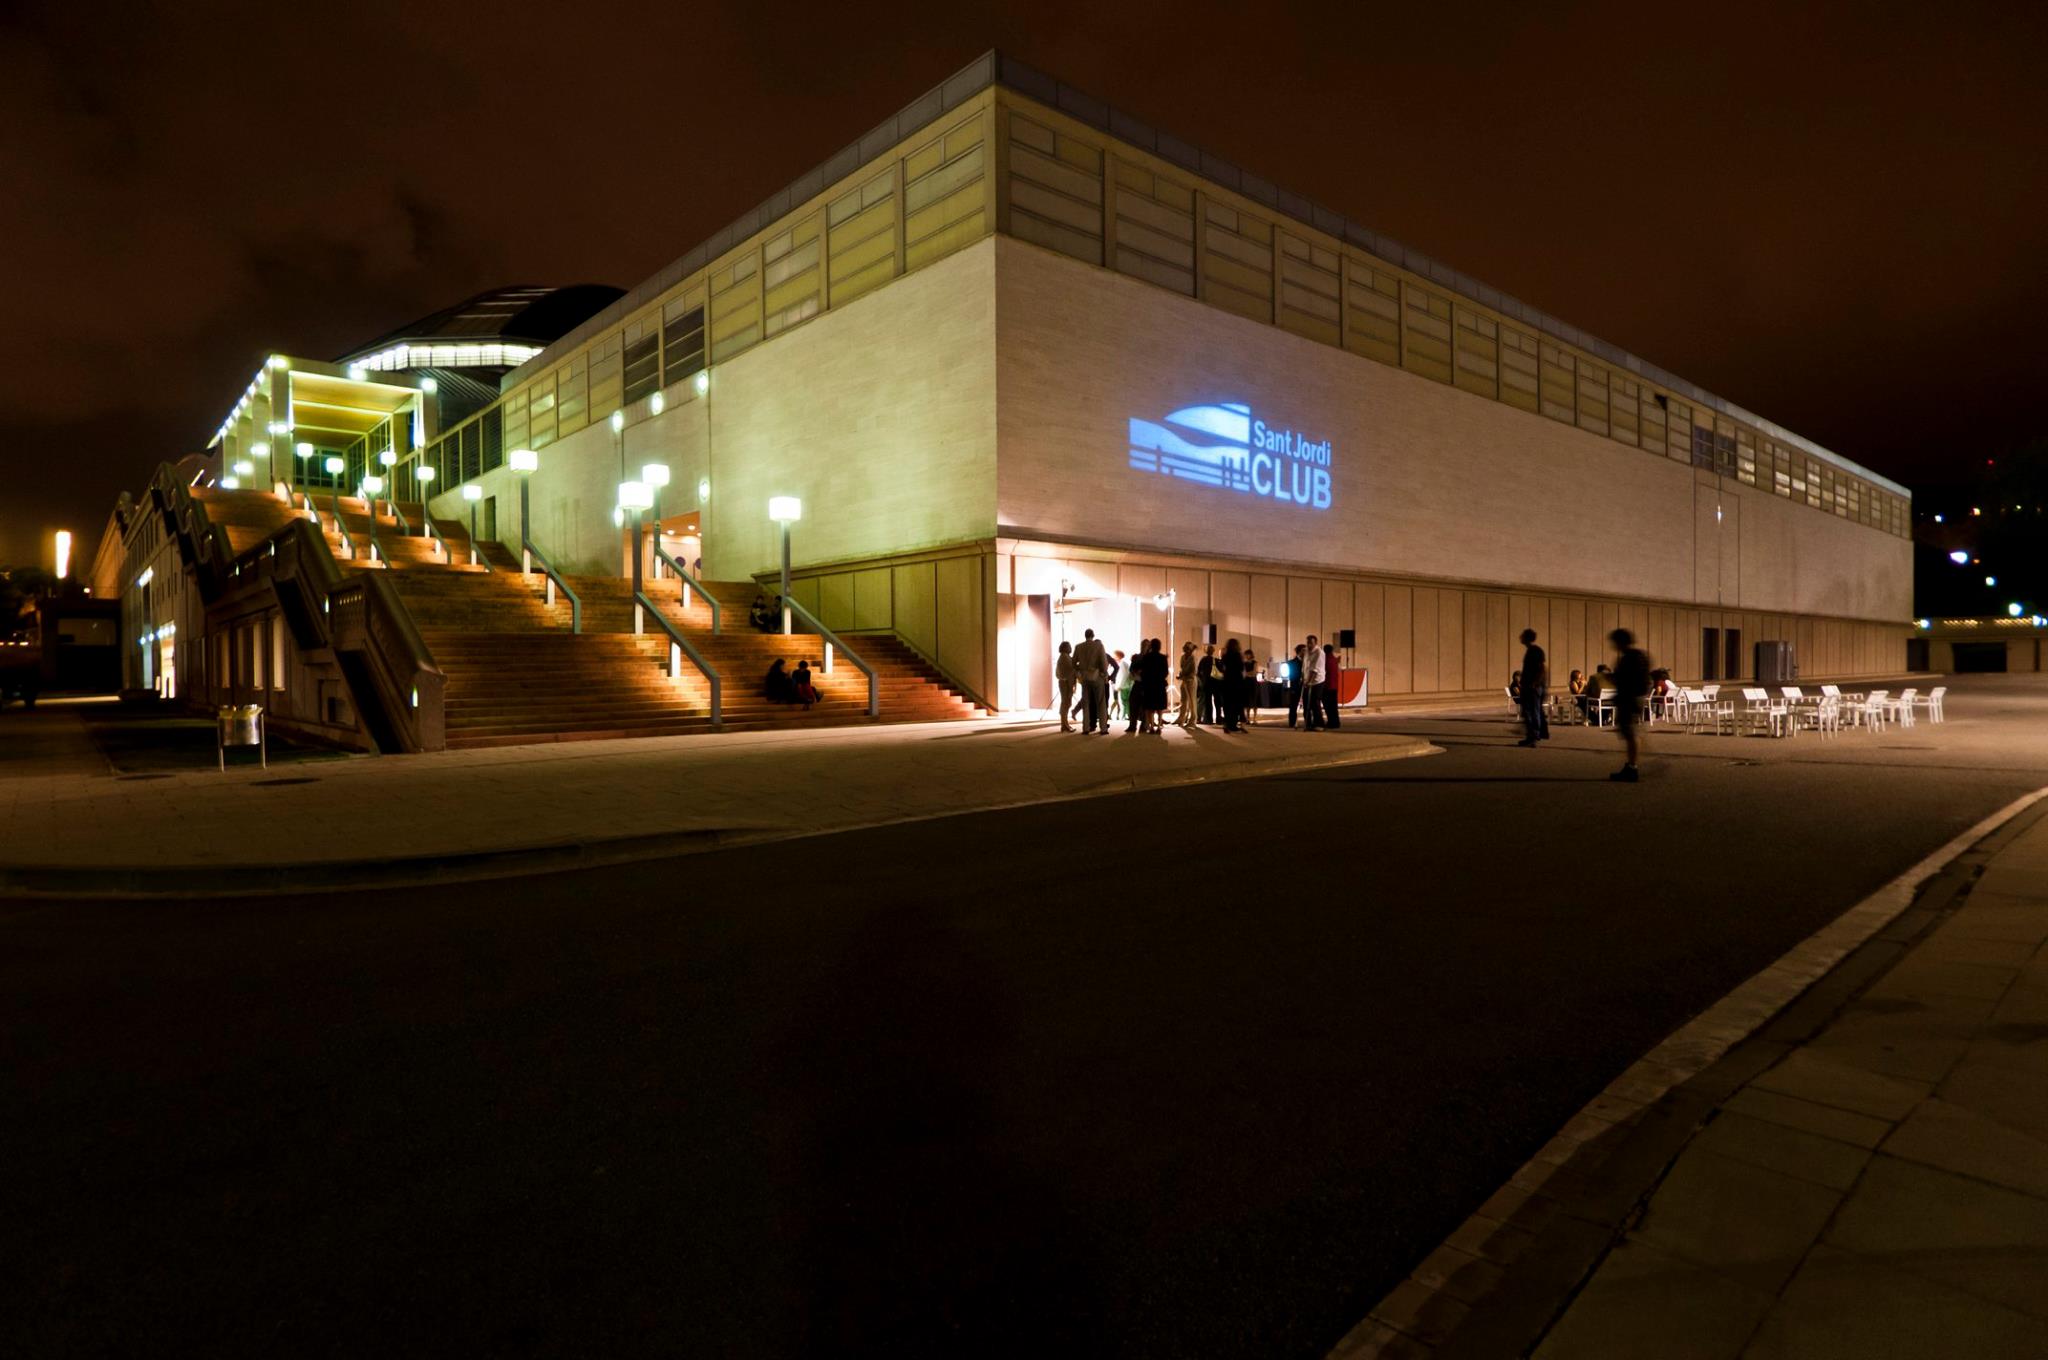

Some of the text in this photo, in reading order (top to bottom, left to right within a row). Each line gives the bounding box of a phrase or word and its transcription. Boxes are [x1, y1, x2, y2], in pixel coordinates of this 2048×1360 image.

[1254, 420, 1331, 467] Sant Jordi
[1252, 453, 1332, 509] CLUB
